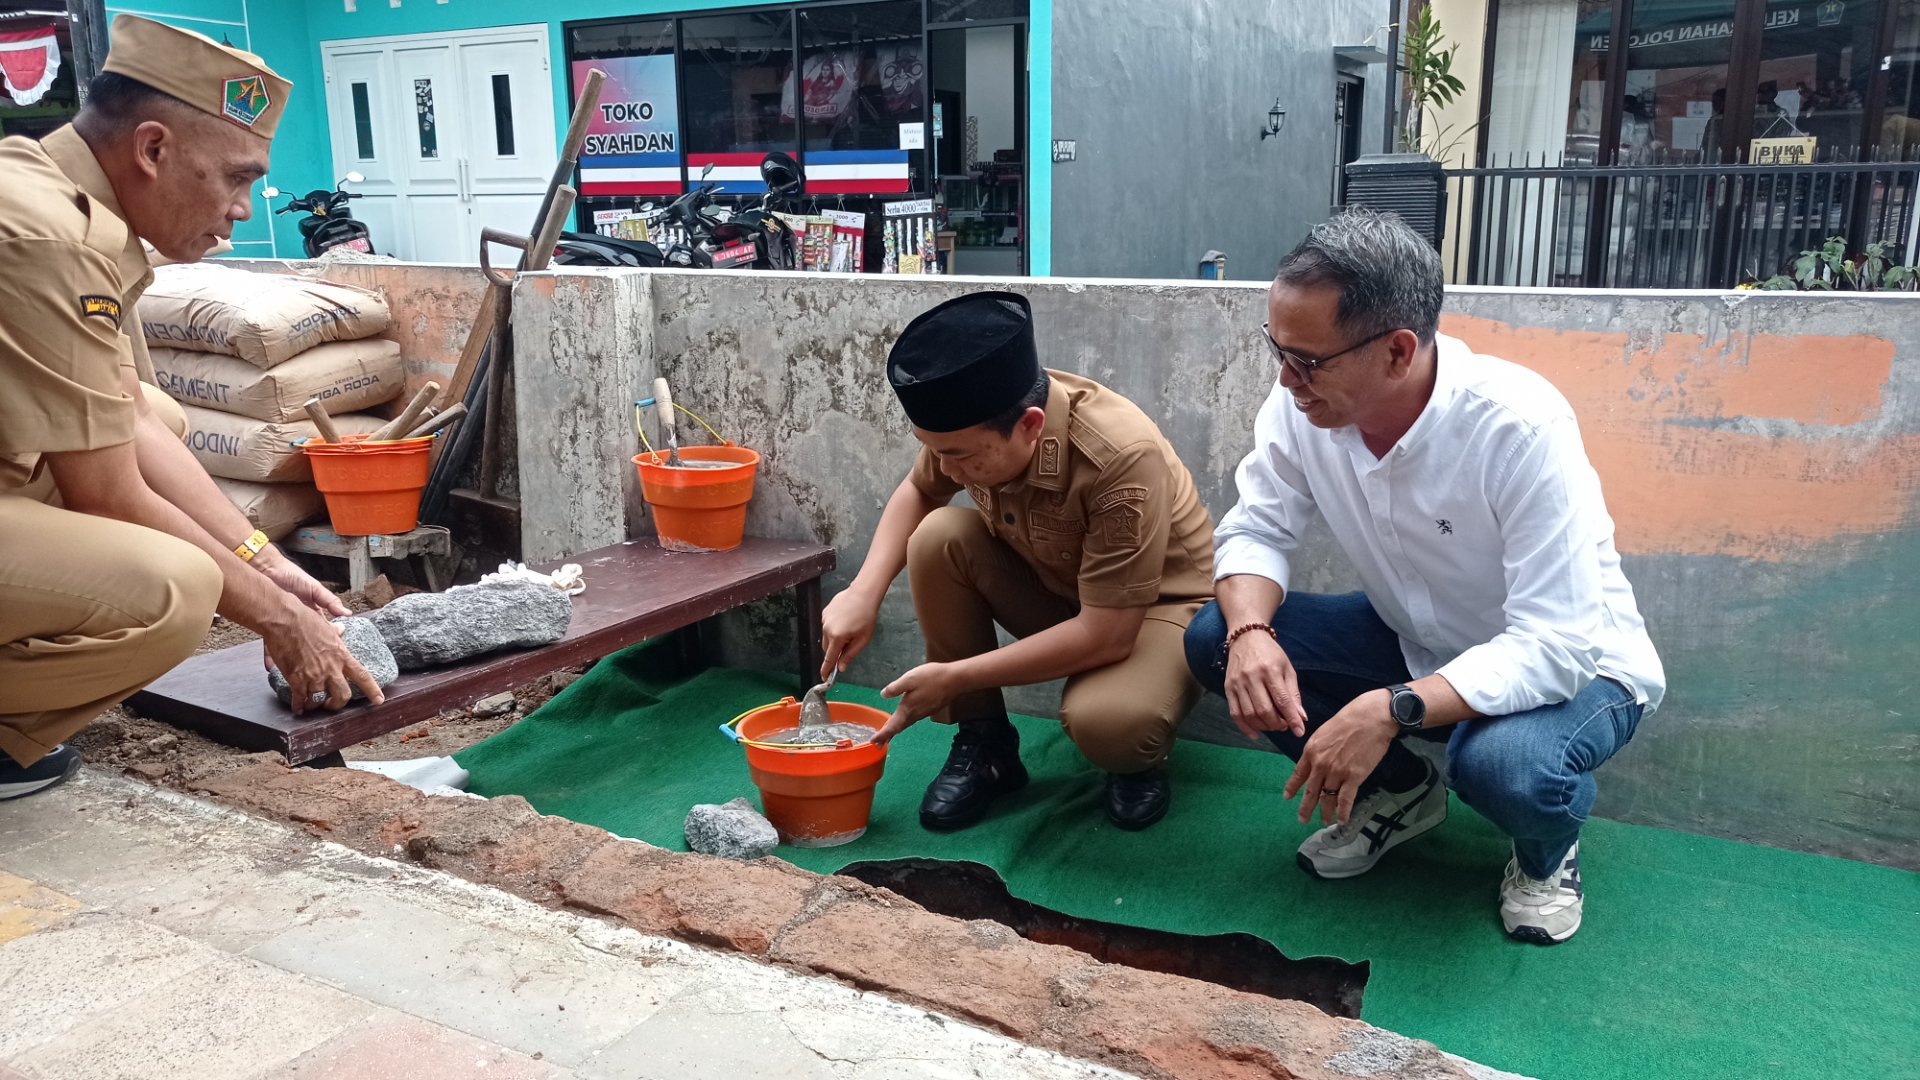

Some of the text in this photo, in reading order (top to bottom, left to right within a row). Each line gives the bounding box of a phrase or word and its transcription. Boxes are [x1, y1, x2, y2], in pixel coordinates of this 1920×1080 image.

[601, 102, 653, 122] TOKO
[585, 132, 675, 154] SYAHDAN
[1760, 145, 1804, 156] BUKA
[900, 202, 917, 213] 4000
[310, 375, 380, 400] TIGA RODA
[335, 376, 353, 385] SEMEN
